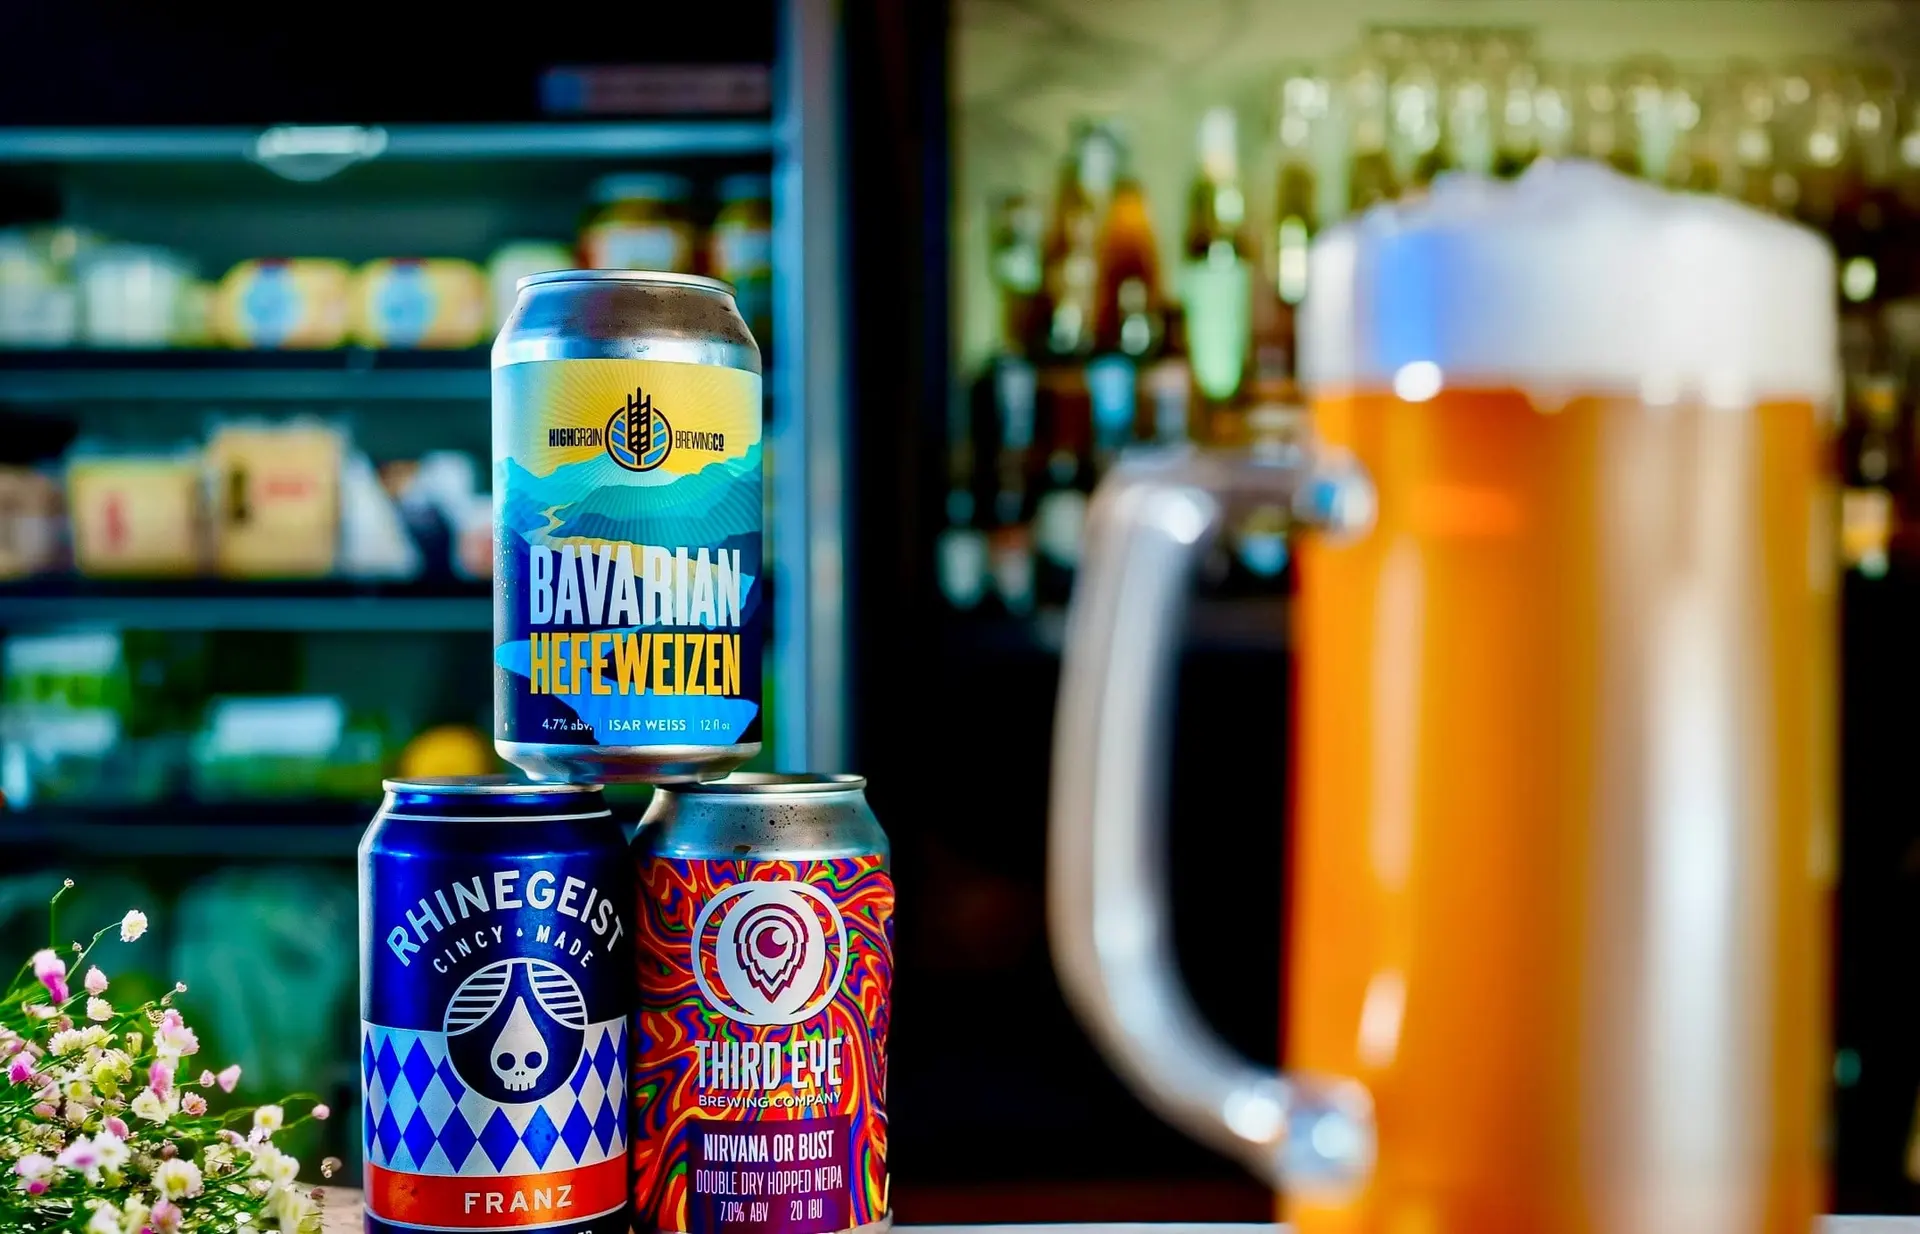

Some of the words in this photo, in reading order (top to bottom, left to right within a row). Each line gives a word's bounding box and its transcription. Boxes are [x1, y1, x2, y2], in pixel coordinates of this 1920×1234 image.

[530, 544, 740, 626] BAVARIAN
[530, 632, 740, 695] HEFEWEIZEN
[542, 718, 568, 731] 4.7%
[571, 718, 593, 731] abv.
[609, 719, 641, 731] ISAR
[645, 719, 686, 731] WEISS
[700, 719, 711, 731] 12
[386, 869, 624, 967] RHINEGEIST
[433, 925, 503, 974] CINCY
[536, 925, 594, 968] MADE
[695, 1039, 782, 1090] THIRD
[792, 1037, 843, 1089] EYE
[699, 1095, 769, 1109] BREWING
[774, 1091, 842, 1109] COMPANY
[703, 1133, 769, 1163] NIRVANA
[773, 1134, 794, 1163] OR
[799, 1130, 835, 1161] BUST
[696, 1169, 738, 1195] DOUBLE
[741, 1171, 765, 1196] DRY
[768, 1169, 812, 1196] HOPPED
[815, 1165, 843, 1191] NEIPA
[464, 1184, 573, 1214] FRANZ
[720, 1201, 745, 1222] 7.0%
[750, 1202, 769, 1222] ABV
[790, 1200, 803, 1221] 20
[808, 1198, 823, 1220] IBU
